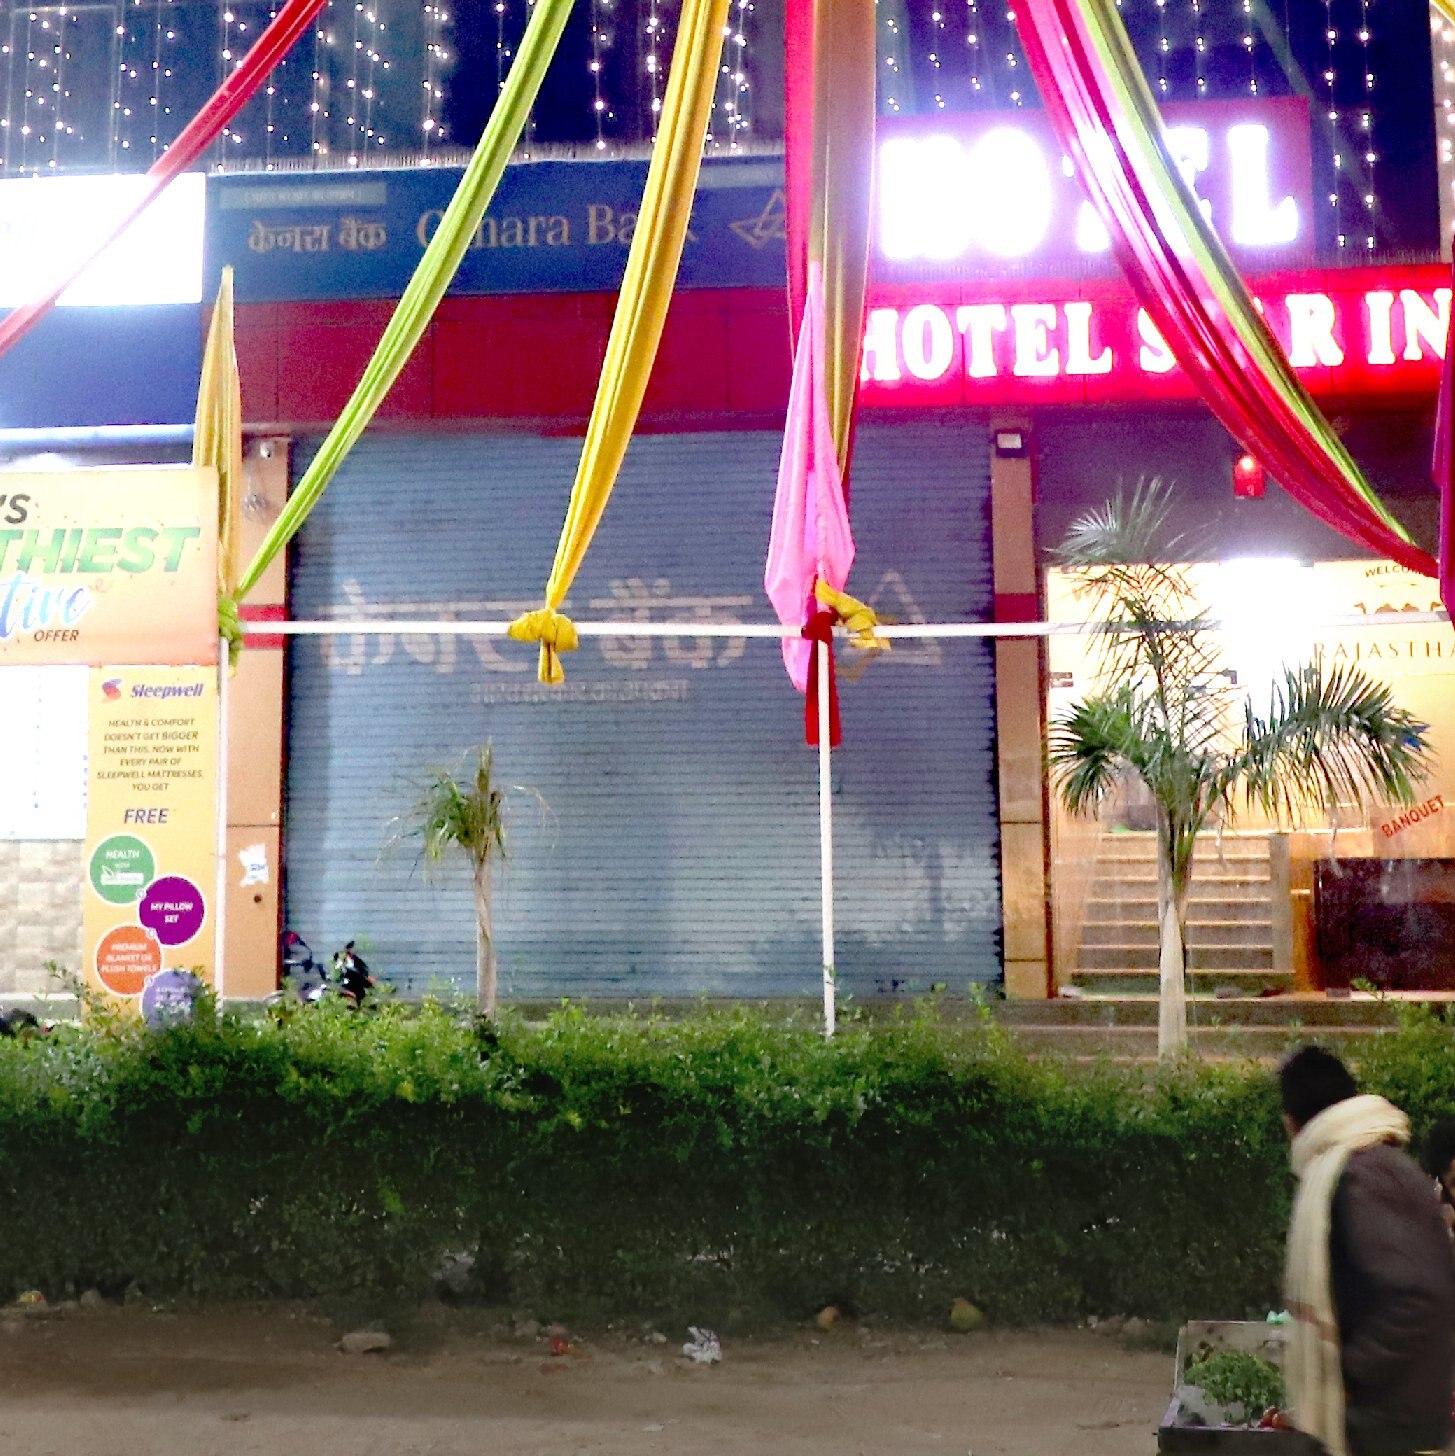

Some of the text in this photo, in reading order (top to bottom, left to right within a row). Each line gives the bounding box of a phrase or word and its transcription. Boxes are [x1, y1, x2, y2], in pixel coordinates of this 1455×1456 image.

[416, 207, 570, 247] Cnara
[860, 301, 1114, 382] HOTEL
[1137, 293, 1344, 374] SR
[33, 629, 80, 643] OFFER
[130, 683, 204, 699] Sleepwell
[124, 808, 169, 825] FREE
[1381, 794, 1445, 838] BANQUET
